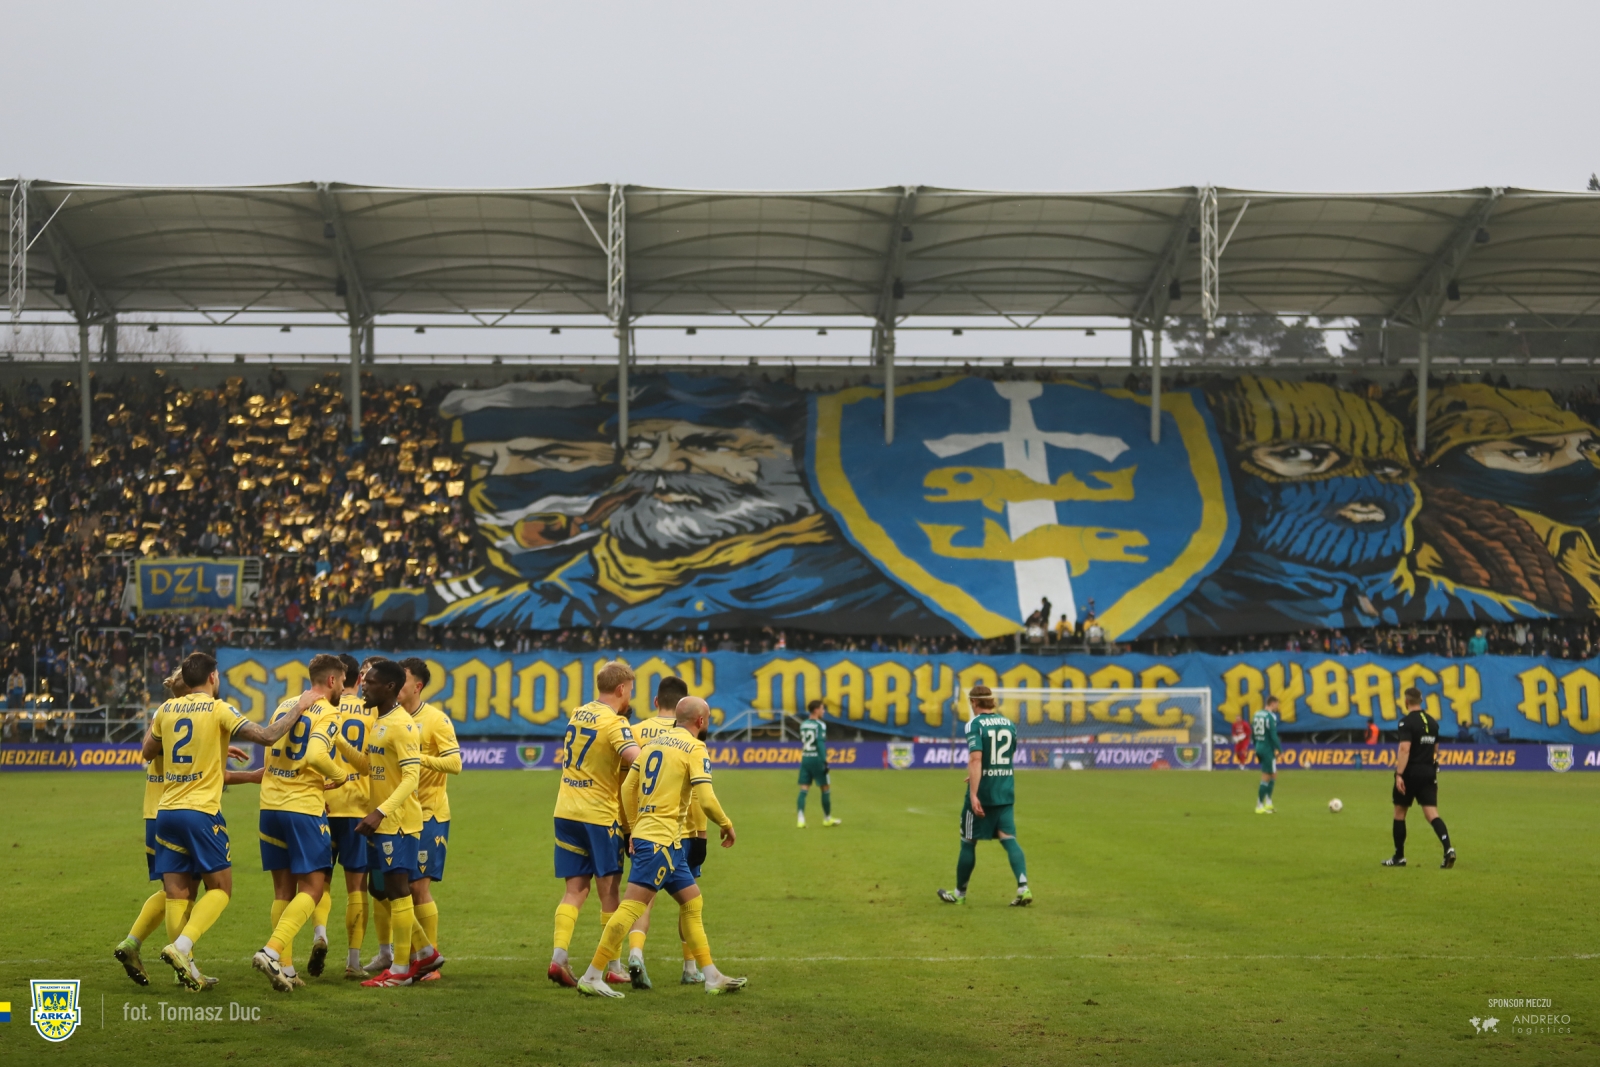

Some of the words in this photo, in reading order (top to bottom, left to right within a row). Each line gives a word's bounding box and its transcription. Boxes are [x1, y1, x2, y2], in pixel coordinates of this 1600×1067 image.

[148, 565, 212, 595] DZL
[173, 702, 214, 713] NAVARRO
[575, 710, 599, 724] KERK
[979, 717, 1011, 727] PANKOV
[172, 717, 193, 763] 2
[564, 724, 597, 770] 37
[987, 728, 1012, 765] 12
[81, 749, 146, 766] GODZIN
[1477, 750, 1516, 765] 12:15
[642, 750, 663, 795] 9
[654, 866, 667, 886] 9
